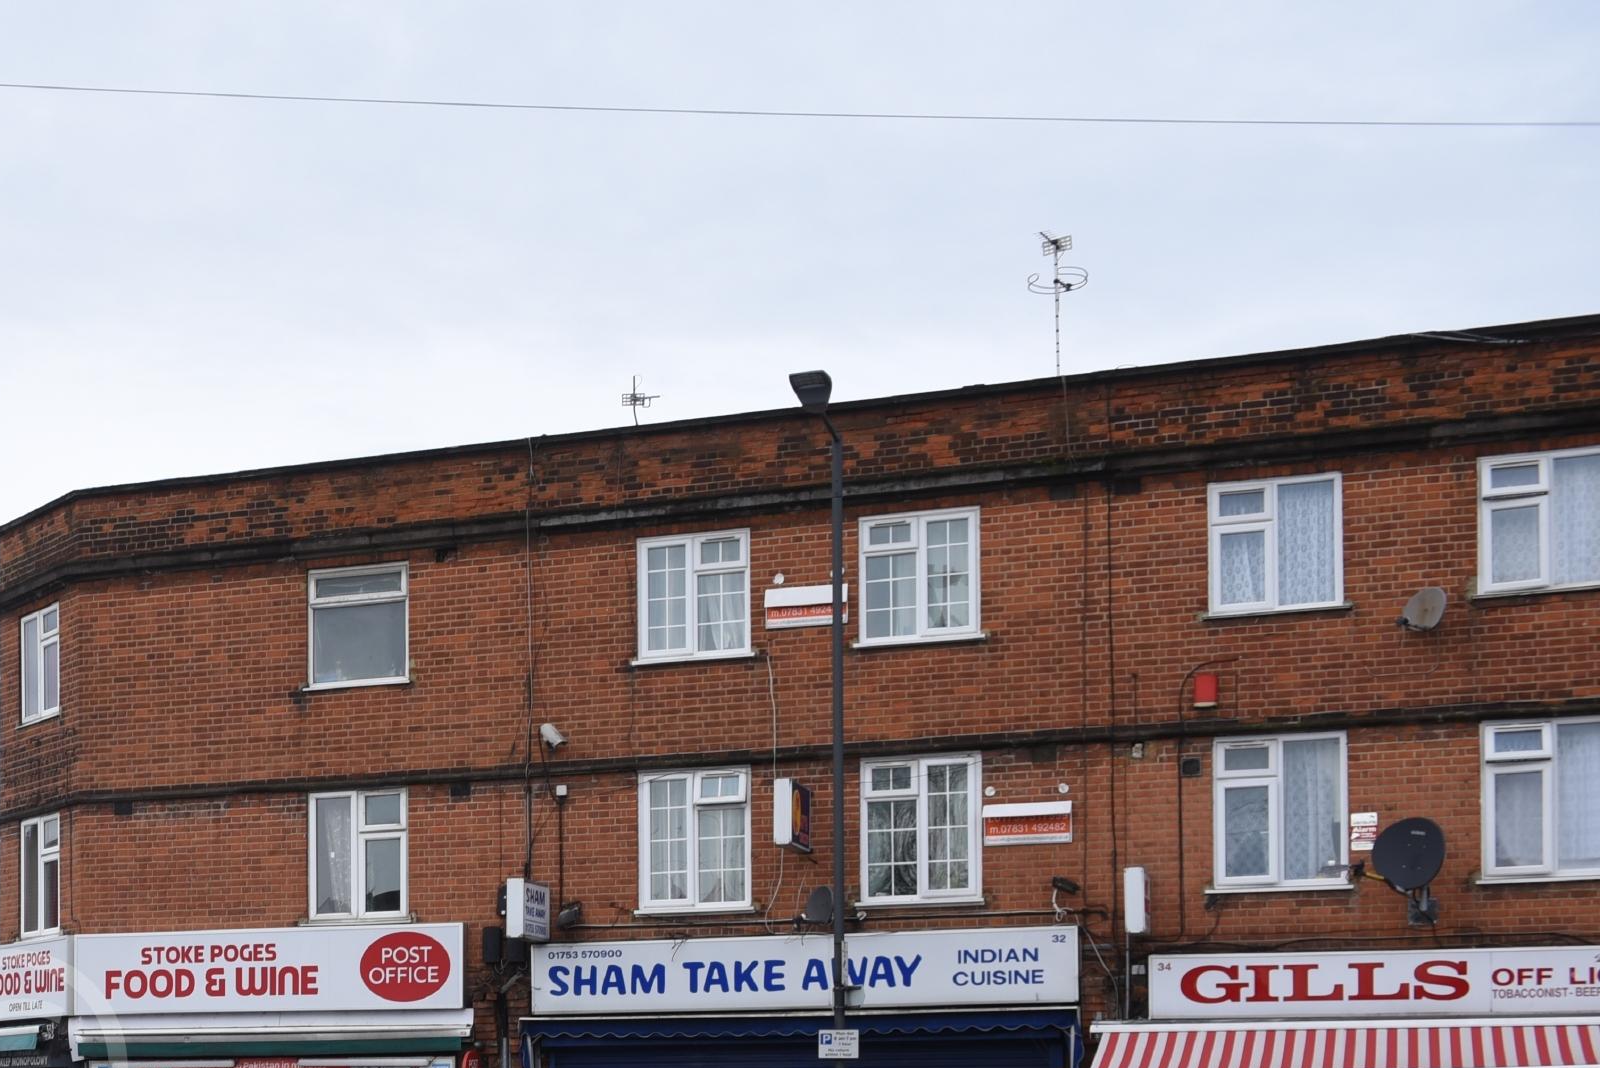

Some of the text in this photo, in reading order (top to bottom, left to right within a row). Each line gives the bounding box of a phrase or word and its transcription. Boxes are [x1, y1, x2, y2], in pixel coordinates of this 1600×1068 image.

[525, 887, 546, 907] SHAM
[1051, 934, 1067, 944] 32
[2, 950, 51, 970] STOKE POGES
[140, 943, 277, 965] STOKE POGES
[381, 945, 433, 965] POST
[547, 949, 623, 960] 01753 570900
[957, 947, 1040, 965] INDIAN
[368, 965, 440, 985] OFFICE
[548, 954, 923, 997] SHAM TAKE AWAY
[1156, 962, 1172, 972] 34
[1491, 966, 1600, 987] OFF LI
[24, 970, 32, 994] &
[105, 965, 319, 1000] FOOD & WINE
[952, 968, 1045, 987] CUISINE
[1180, 959, 1471, 1004] GILLS
[1491, 987, 1569, 999] TOBACCONIST
[8, 1002, 22, 1012] OPEN
[31, 1000, 43, 1010] LATE
[468, 1059, 480, 1068] POST
